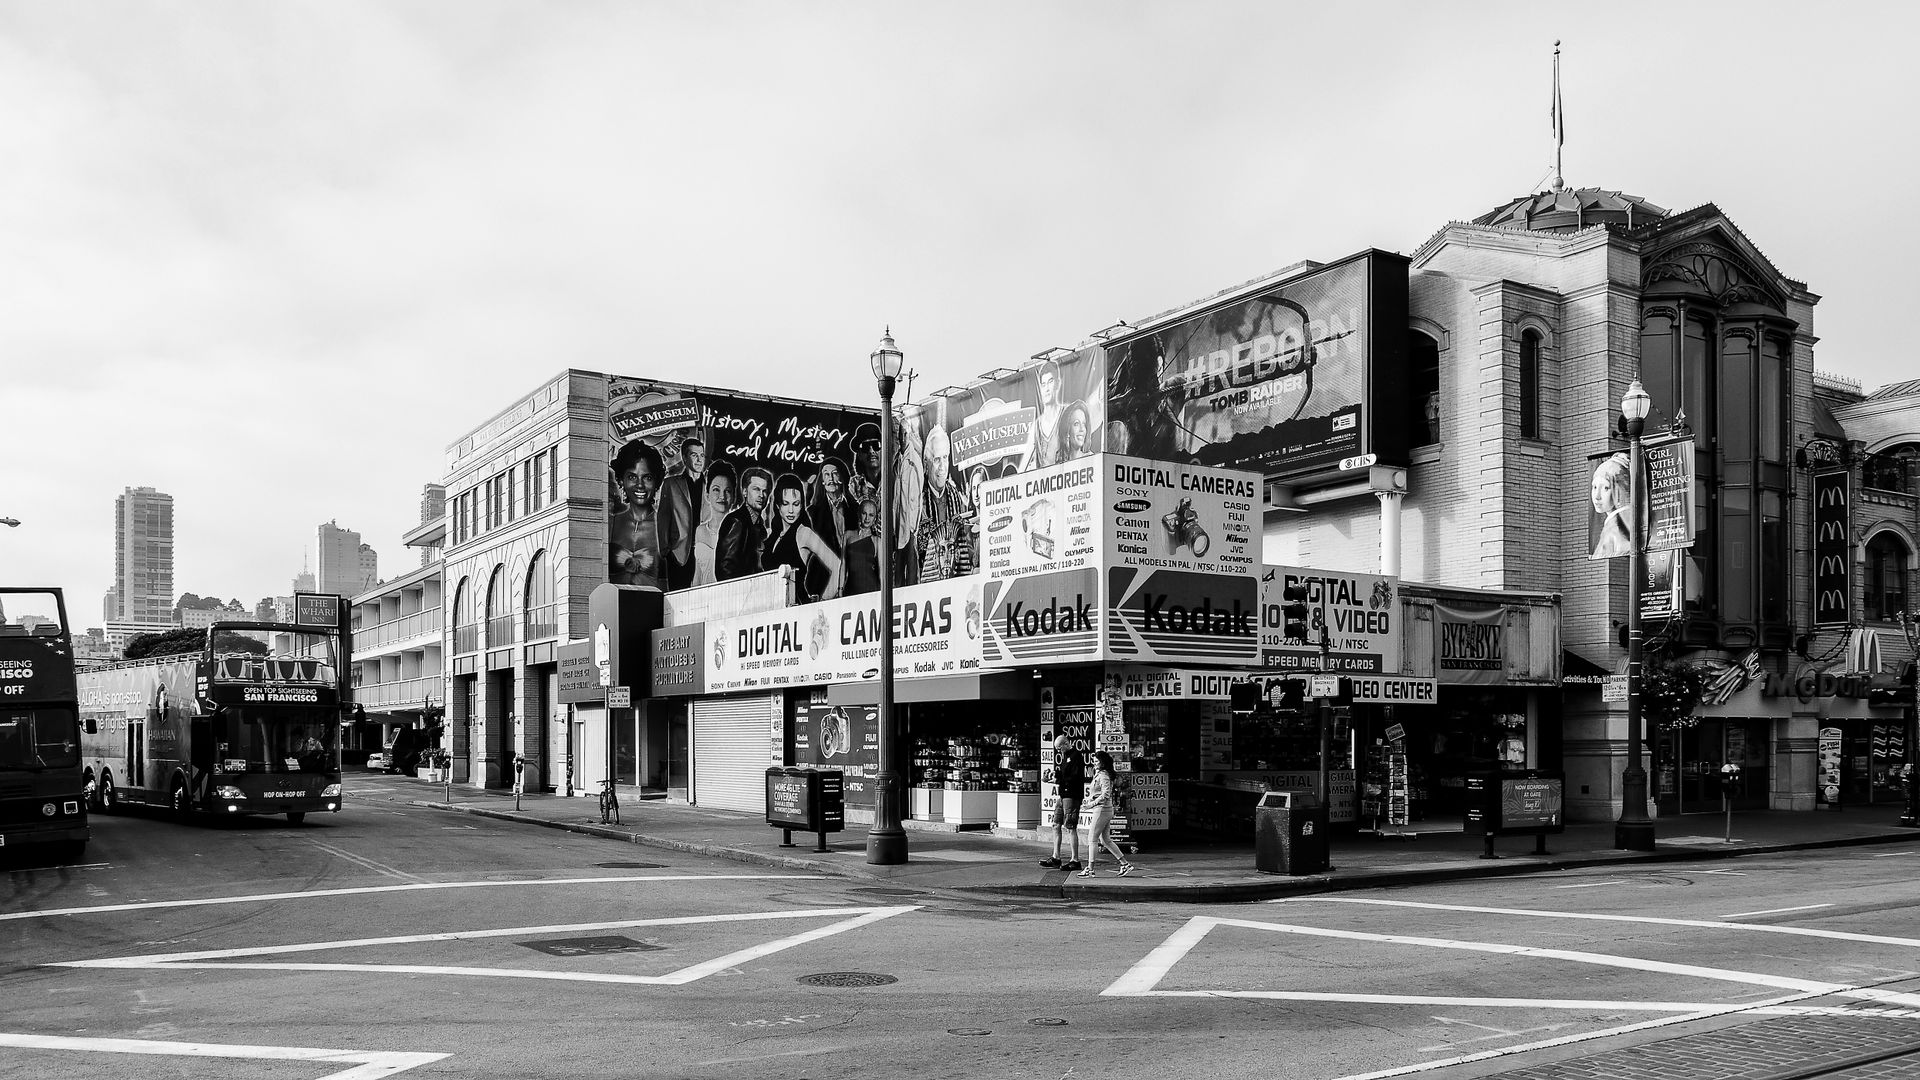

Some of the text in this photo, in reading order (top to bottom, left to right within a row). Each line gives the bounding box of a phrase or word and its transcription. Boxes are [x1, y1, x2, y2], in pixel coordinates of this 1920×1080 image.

[1210, 375, 1302, 412] TOMB RAIDER
[1234, 406, 1248, 415] NOW
[616, 407, 697, 431] WAX MUSEUM
[701, 404, 848, 449] History, Mystery
[953, 422, 1033, 455] WAX MUSEUM
[725, 435, 824, 463] and Movies
[1649, 449, 1672, 460] GIRL
[1650, 457, 1675, 469] WITH
[1651, 467, 1678, 480] PEARL
[1115, 464, 1254, 497] DIGITAL CAMERAS
[1652, 474, 1691, 490] EARRING
[986, 467, 1094, 506] DIGITAL CAMCORDER
[1116, 487, 1149, 497] SONY
[1068, 491, 1091, 502] CASIO
[989, 507, 1012, 516] SONY
[1072, 503, 1087, 513] FUJI
[1117, 502, 1147, 511] SAMSUNG
[1223, 502, 1250, 511] CASIO
[1115, 516, 1150, 529] Canon
[1229, 513, 1245, 521] FUJI
[1070, 526, 1090, 536] Nikon
[1223, 523, 1251, 532] MINOLTA
[989, 534, 1012, 545] Canon
[1116, 531, 1148, 542] PENTAX
[1226, 534, 1248, 544] Nikon
[990, 546, 1011, 557] PENTAX
[1065, 547, 1094, 557] OLYMPUS
[1118, 543, 1147, 555] Konica
[1230, 546, 1244, 554] JVC
[990, 559, 1010, 568] Konica
[1124, 557, 1137, 565] ALL
[1139, 558, 1167, 567] MODELS
[1178, 560, 1190, 569] PAL
[1198, 563, 1214, 572] NTSC
[1220, 555, 1253, 564] OLYMPUS
[991, 571, 1000, 579] ALL
[1001, 567, 1021, 577] MODELS
[1029, 565, 1038, 574] PAL
[1043, 562, 1057, 571] NTSC
[1062, 558, 1085, 568] 110-220
[1285, 575, 1363, 606] DGTAL
[308, 599, 328, 607] THE
[301, 607, 336, 616] WHARF
[1006, 594, 1092, 638] Kodak
[1144, 593, 1251, 636] Kodak
[1312, 607, 1322, 630] &
[1333, 608, 1389, 635] VIDEO
[739, 596, 951, 658] DIGITAL CAMERAS
[659, 635, 691, 651] FINE ART
[1345, 639, 1369, 650] NTSC
[842, 640, 949, 660] FULL LINE OF ACCESSORIES
[655, 654, 688, 668] ANTIQUES
[747, 657, 799, 670] SPEED MEMORY CARDS
[1268, 655, 1298, 667] SPEED
[1345, 658, 1374, 670] CARDS
[1460, 661, 1500, 669] FRANCISCO
[0, 669, 33, 678] ISCO
[655, 671, 693, 685] FURNITURE
[761, 677, 770, 685] FUJI
[774, 676, 789, 684] PENTAX
[814, 672, 832, 681] CASIO
[914, 661, 936, 672] Kodak
[1127, 674, 1143, 682] ALL
[4, 685, 24, 695] OFF
[1126, 682, 1181, 697] ON SALE
[1353, 681, 1379, 699] DEO
[1384, 681, 1433, 700] CENTER
[244, 693, 318, 702] SAN FRANCISCO
[1041, 711, 1054, 722] SALE
[1059, 711, 1093, 724] CANON
[1062, 726, 1088, 737] SONY
[1041, 751, 1054, 761] SALE
[1132, 775, 1166, 786] IGITAL
[1131, 789, 1166, 799] AMERA
